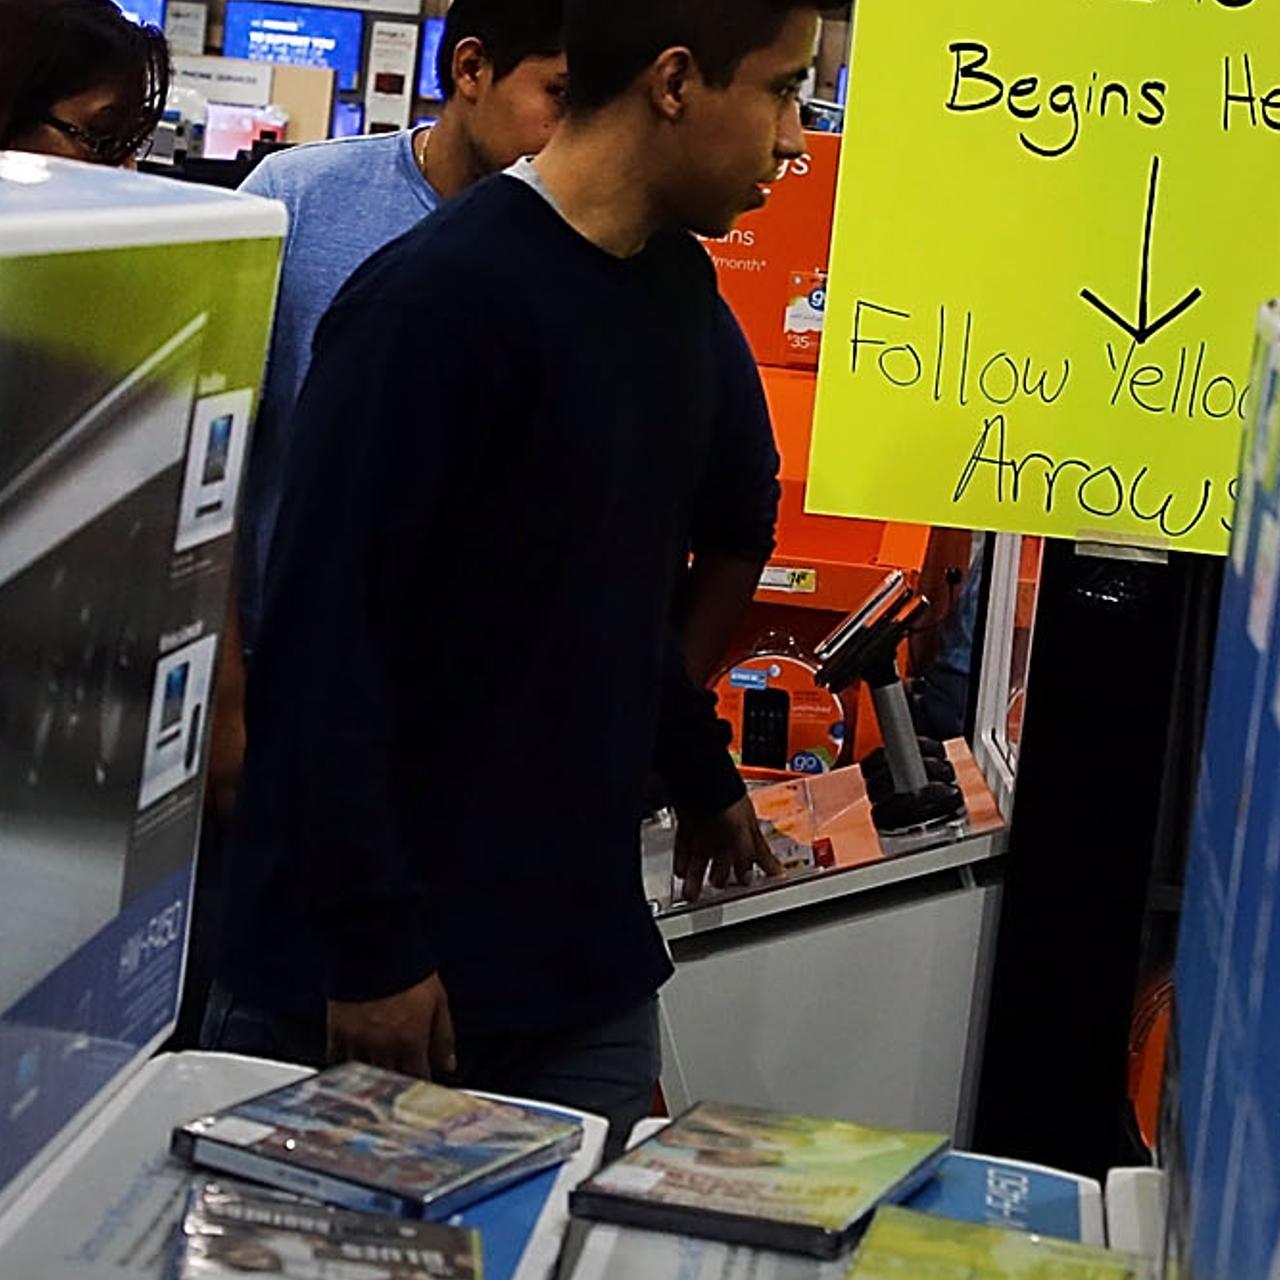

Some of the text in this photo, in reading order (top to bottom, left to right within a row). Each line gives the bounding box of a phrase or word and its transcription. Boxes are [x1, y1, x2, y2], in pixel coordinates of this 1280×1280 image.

[945, 42, 1167, 157] Begins
[850, 300, 1071, 408] Follow
[793, 756, 817, 771] go
